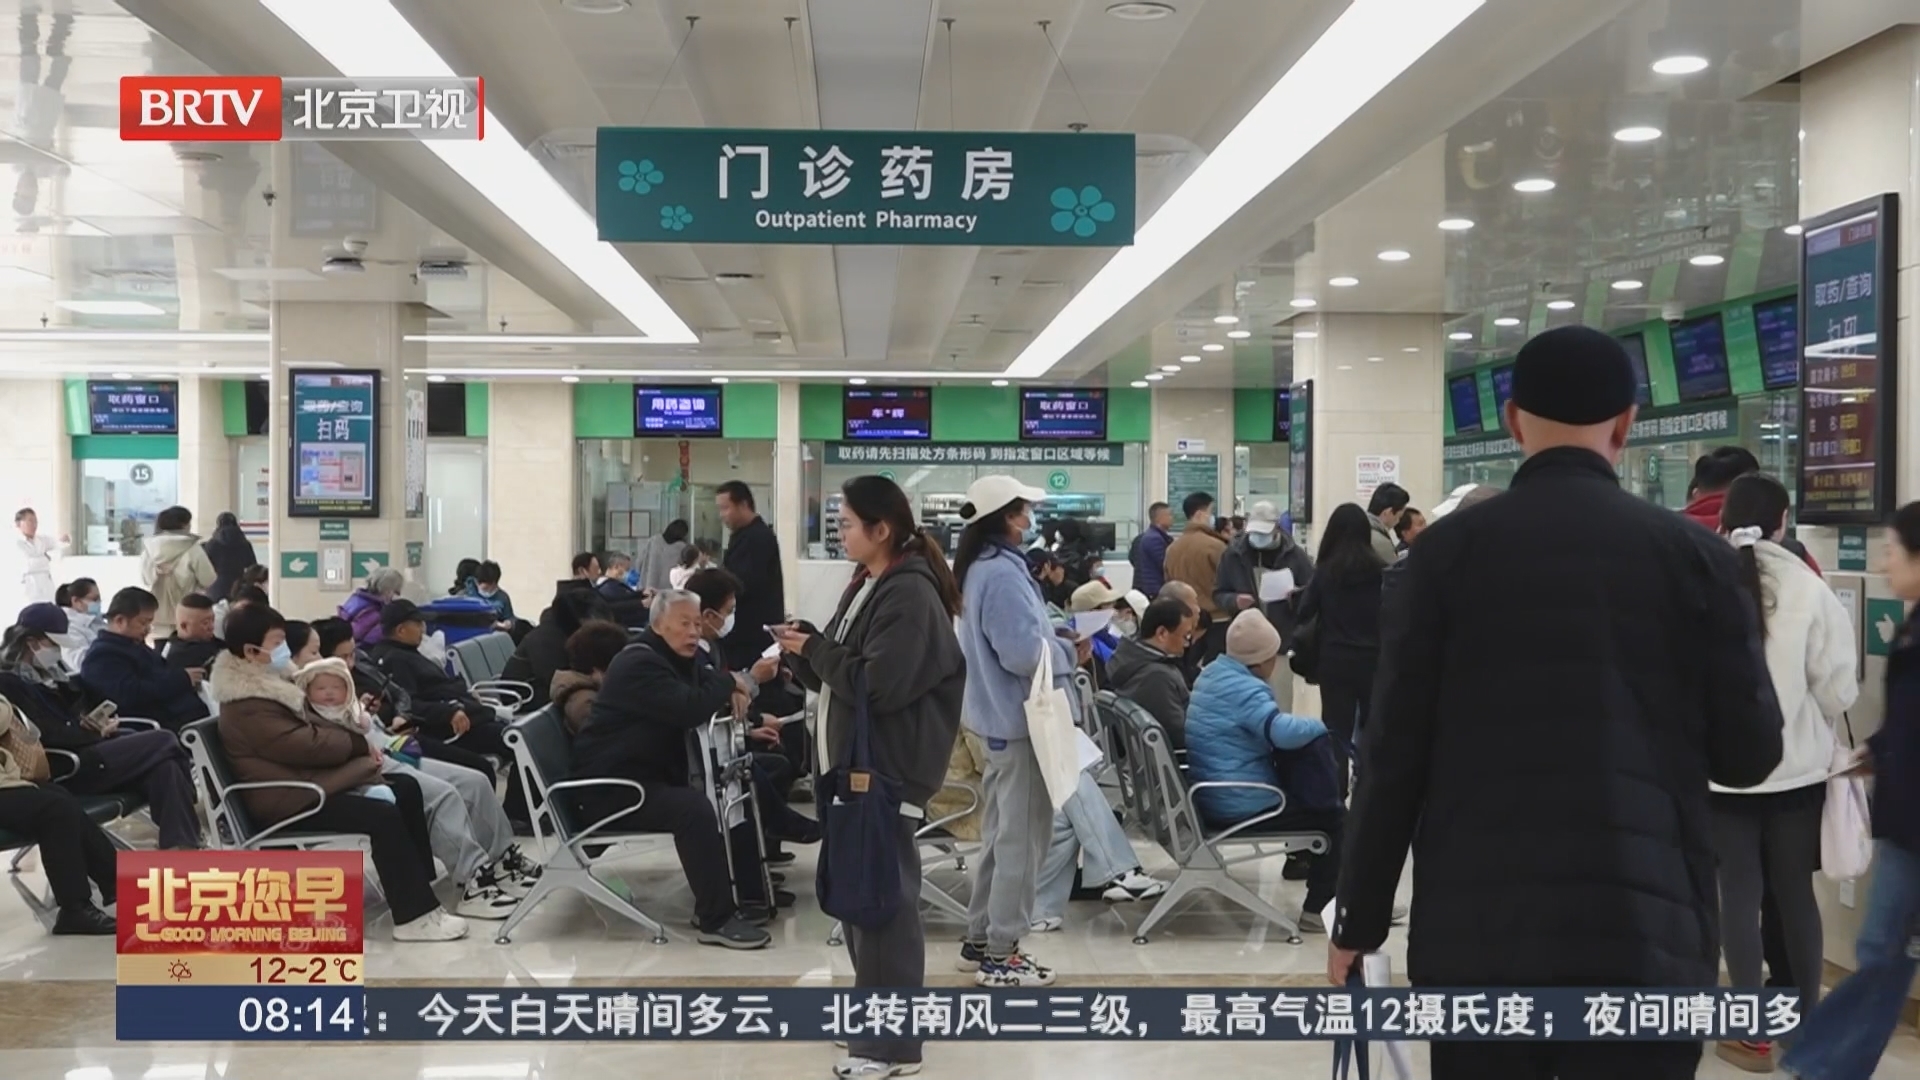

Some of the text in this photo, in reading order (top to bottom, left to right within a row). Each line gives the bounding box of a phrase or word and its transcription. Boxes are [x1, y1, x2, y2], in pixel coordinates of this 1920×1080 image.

[718, 144, 1014, 202] 门诊药房
[755, 209, 978, 233] Outpatient Pharmacy
[317, 417, 350, 440] 扫码
[838, 445, 1110, 462] 取药请先扫描处方条形码 到指定窗口区域等候
[134, 467, 150, 481] 15
[1648, 455, 1657, 477] 6
[1052, 474, 1065, 487] 12
